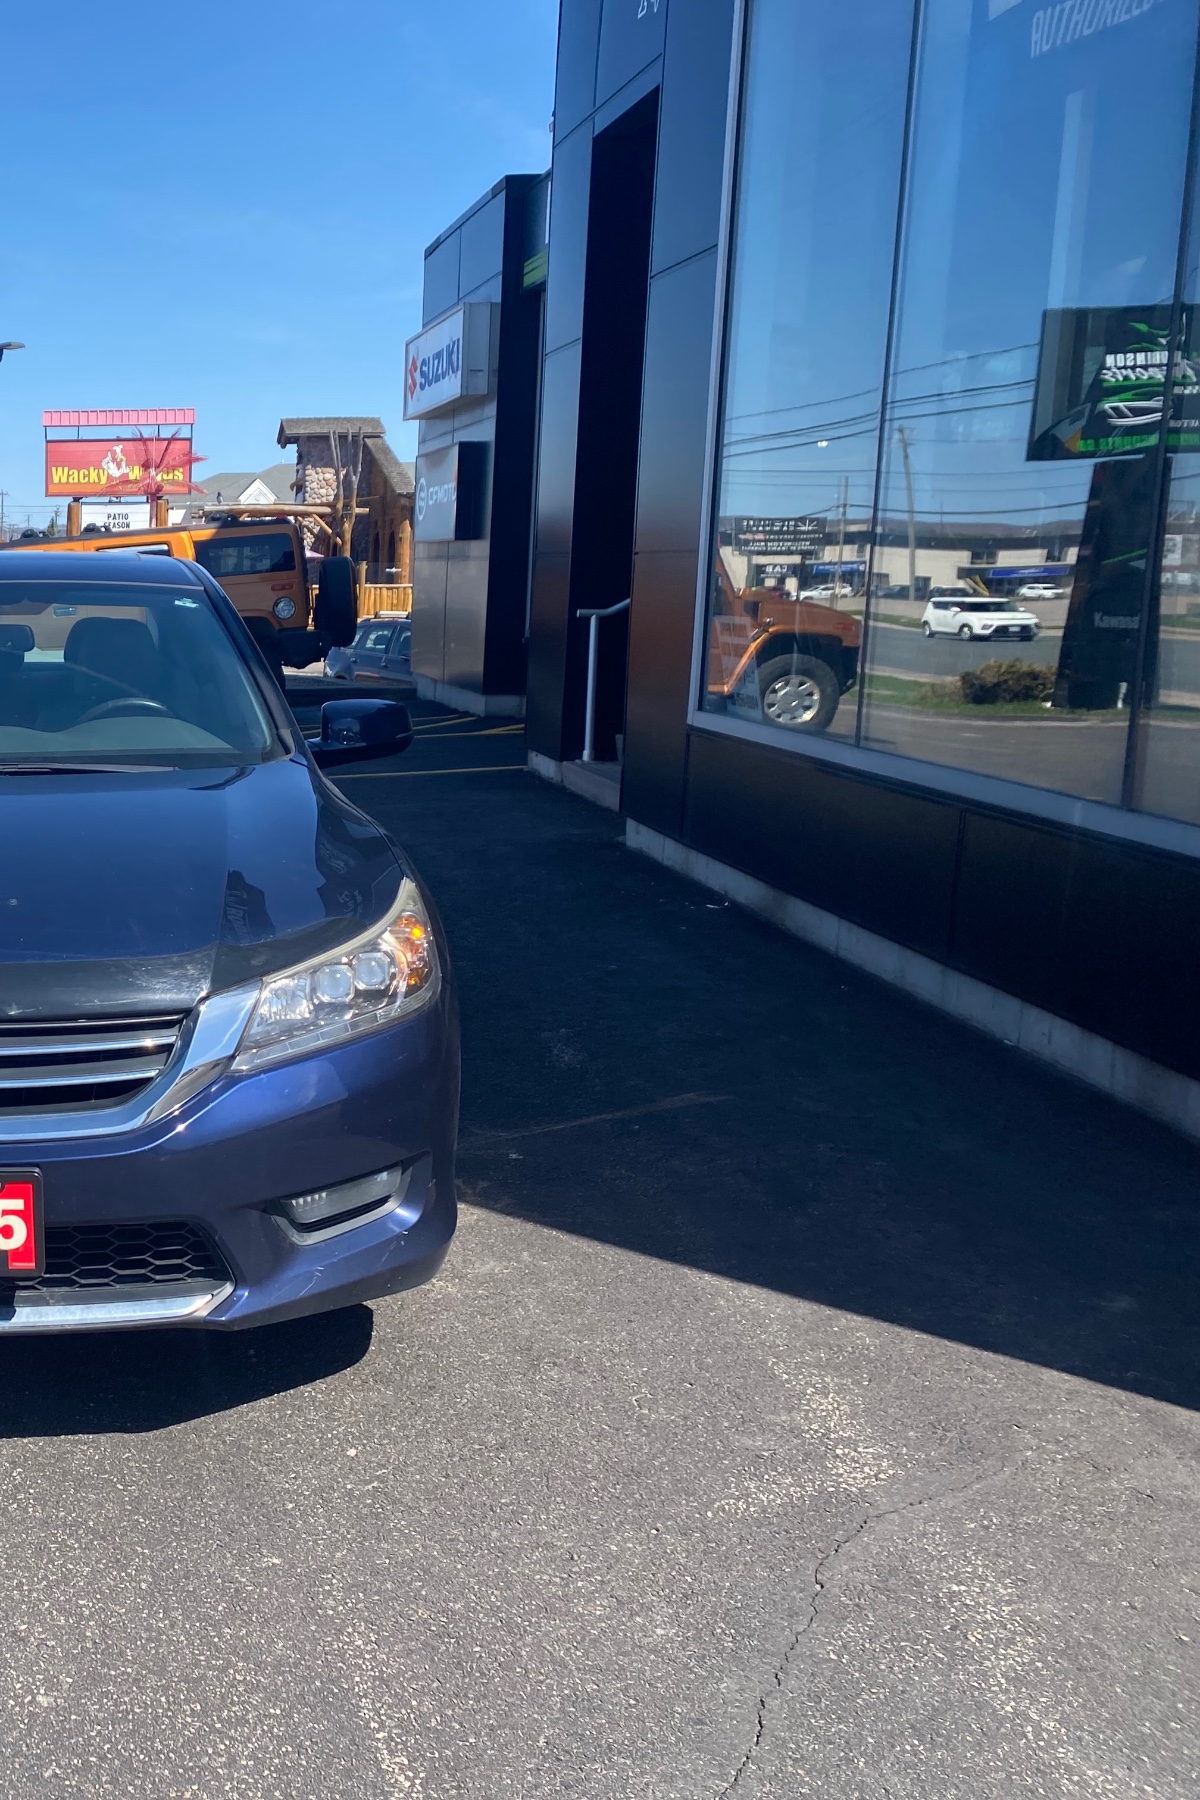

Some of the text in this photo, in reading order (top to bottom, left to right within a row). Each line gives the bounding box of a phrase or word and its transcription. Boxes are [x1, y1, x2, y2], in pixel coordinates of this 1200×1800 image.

[419, 337, 460, 391] SUZUKI
[52, 466, 108, 485] Wacky
[107, 513, 129, 521] PATIO
